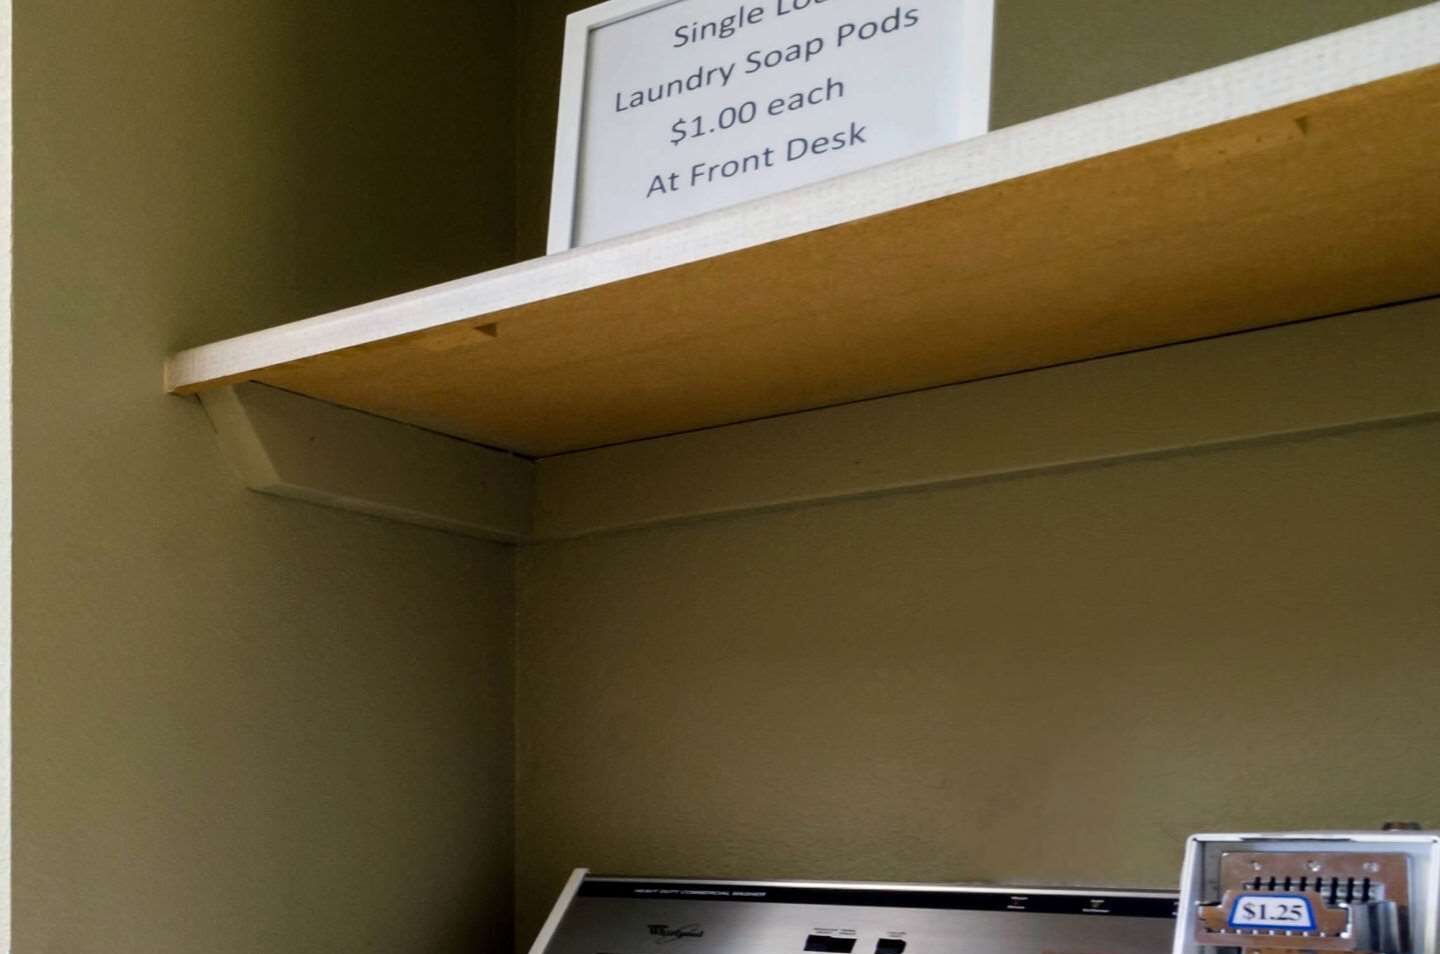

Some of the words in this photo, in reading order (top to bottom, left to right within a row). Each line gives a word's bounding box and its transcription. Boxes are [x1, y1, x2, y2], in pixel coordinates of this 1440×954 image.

[672, 5, 764, 48] Single
[777, 0, 830, 16] Lo
[615, 61, 736, 113] Laundry
[745, 37, 824, 75] Soap
[836, 7, 919, 47] Pods
[670, 101, 757, 146] $1.00
[767, 77, 845, 117] each
[647, 172, 678, 199] At
[690, 146, 775, 187] Front
[786, 122, 867, 162] Desk
[647, 924, 704, 939] Whirlpool
[1243, 902, 1303, 921] $1.25
